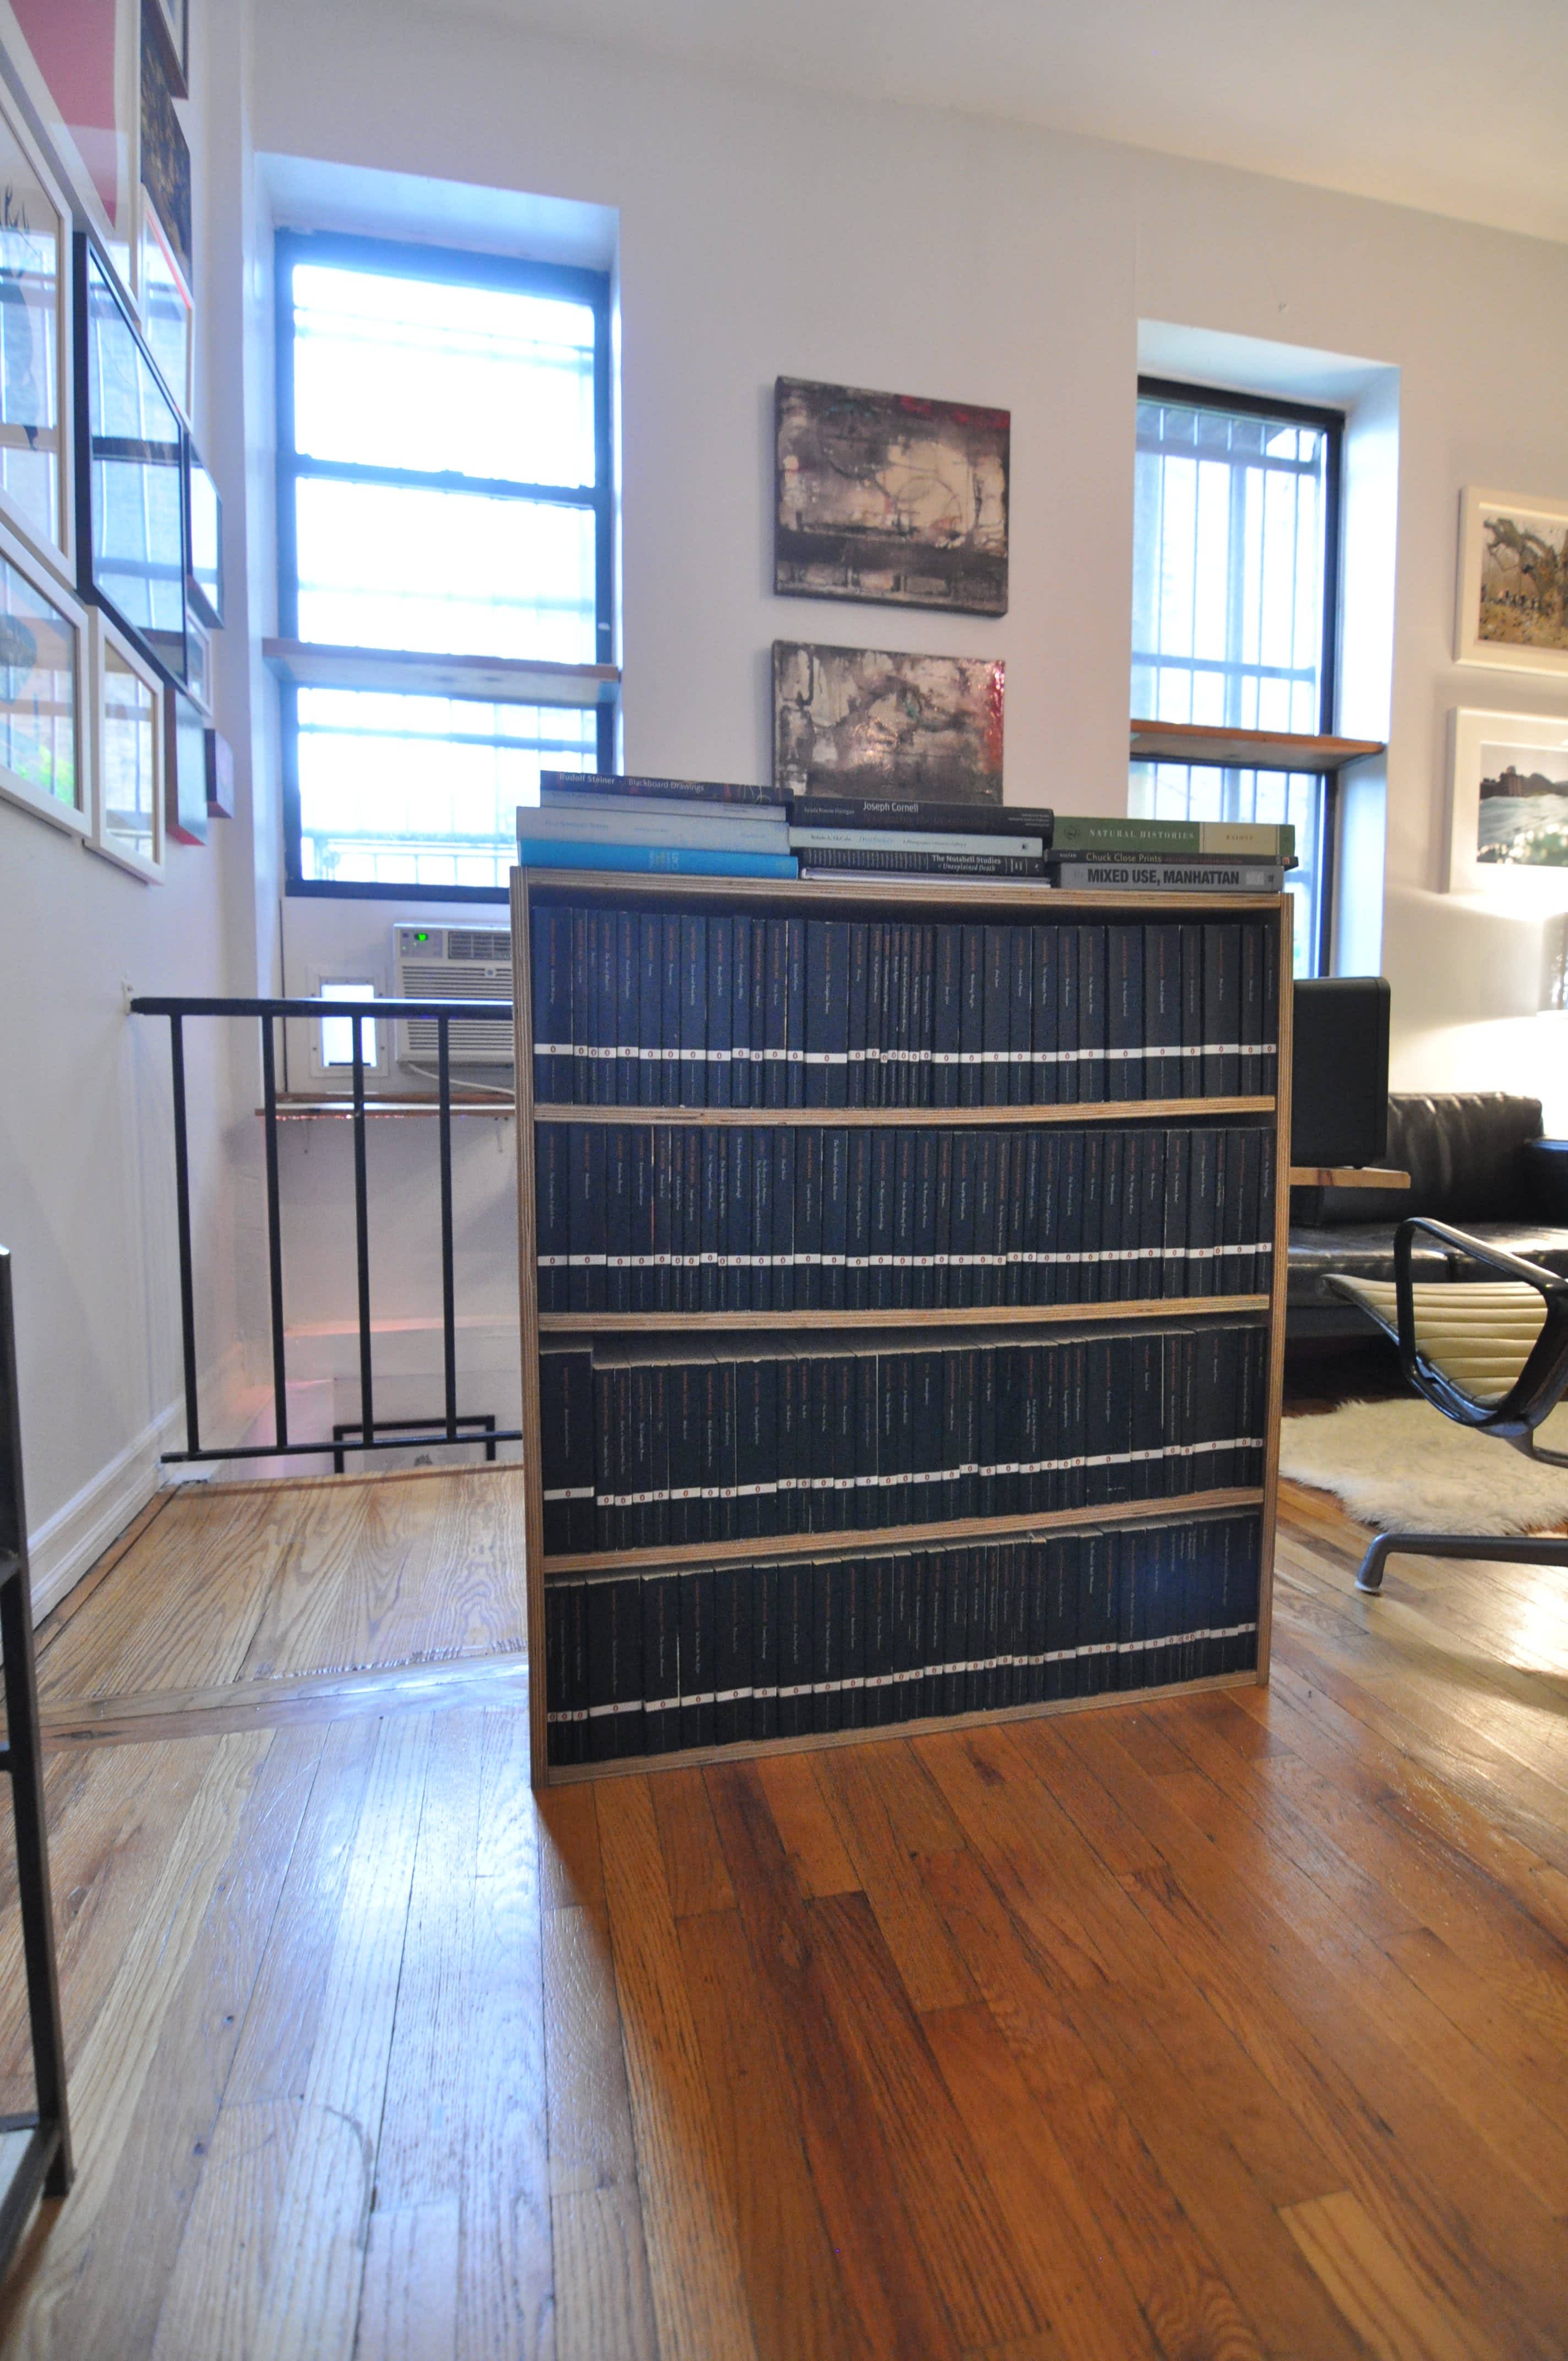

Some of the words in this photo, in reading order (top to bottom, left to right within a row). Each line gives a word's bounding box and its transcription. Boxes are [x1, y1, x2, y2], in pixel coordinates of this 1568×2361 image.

[559, 773, 585, 782] Rudolf
[587, 775, 616, 785] Steiner
[629, 778, 669, 789] Blackboard
[671, 782, 705, 793] Drawings
[863, 801, 890, 813] Joseph
[891, 802, 919, 813] Cornell
[1089, 829, 1135, 838] NATURAL
[1140, 830, 1195, 840] HISTORIES
[1086, 852, 1111, 862] Chuck
[1114, 853, 1136, 863] Close
[1139, 854, 1162, 863] Prints
[943, 863, 978, 872] Unexplained
[1087, 868, 1129, 884] MIXED
[1132, 869, 1161, 886] USE,
[1163, 871, 1240, 885] MANHATTAN
